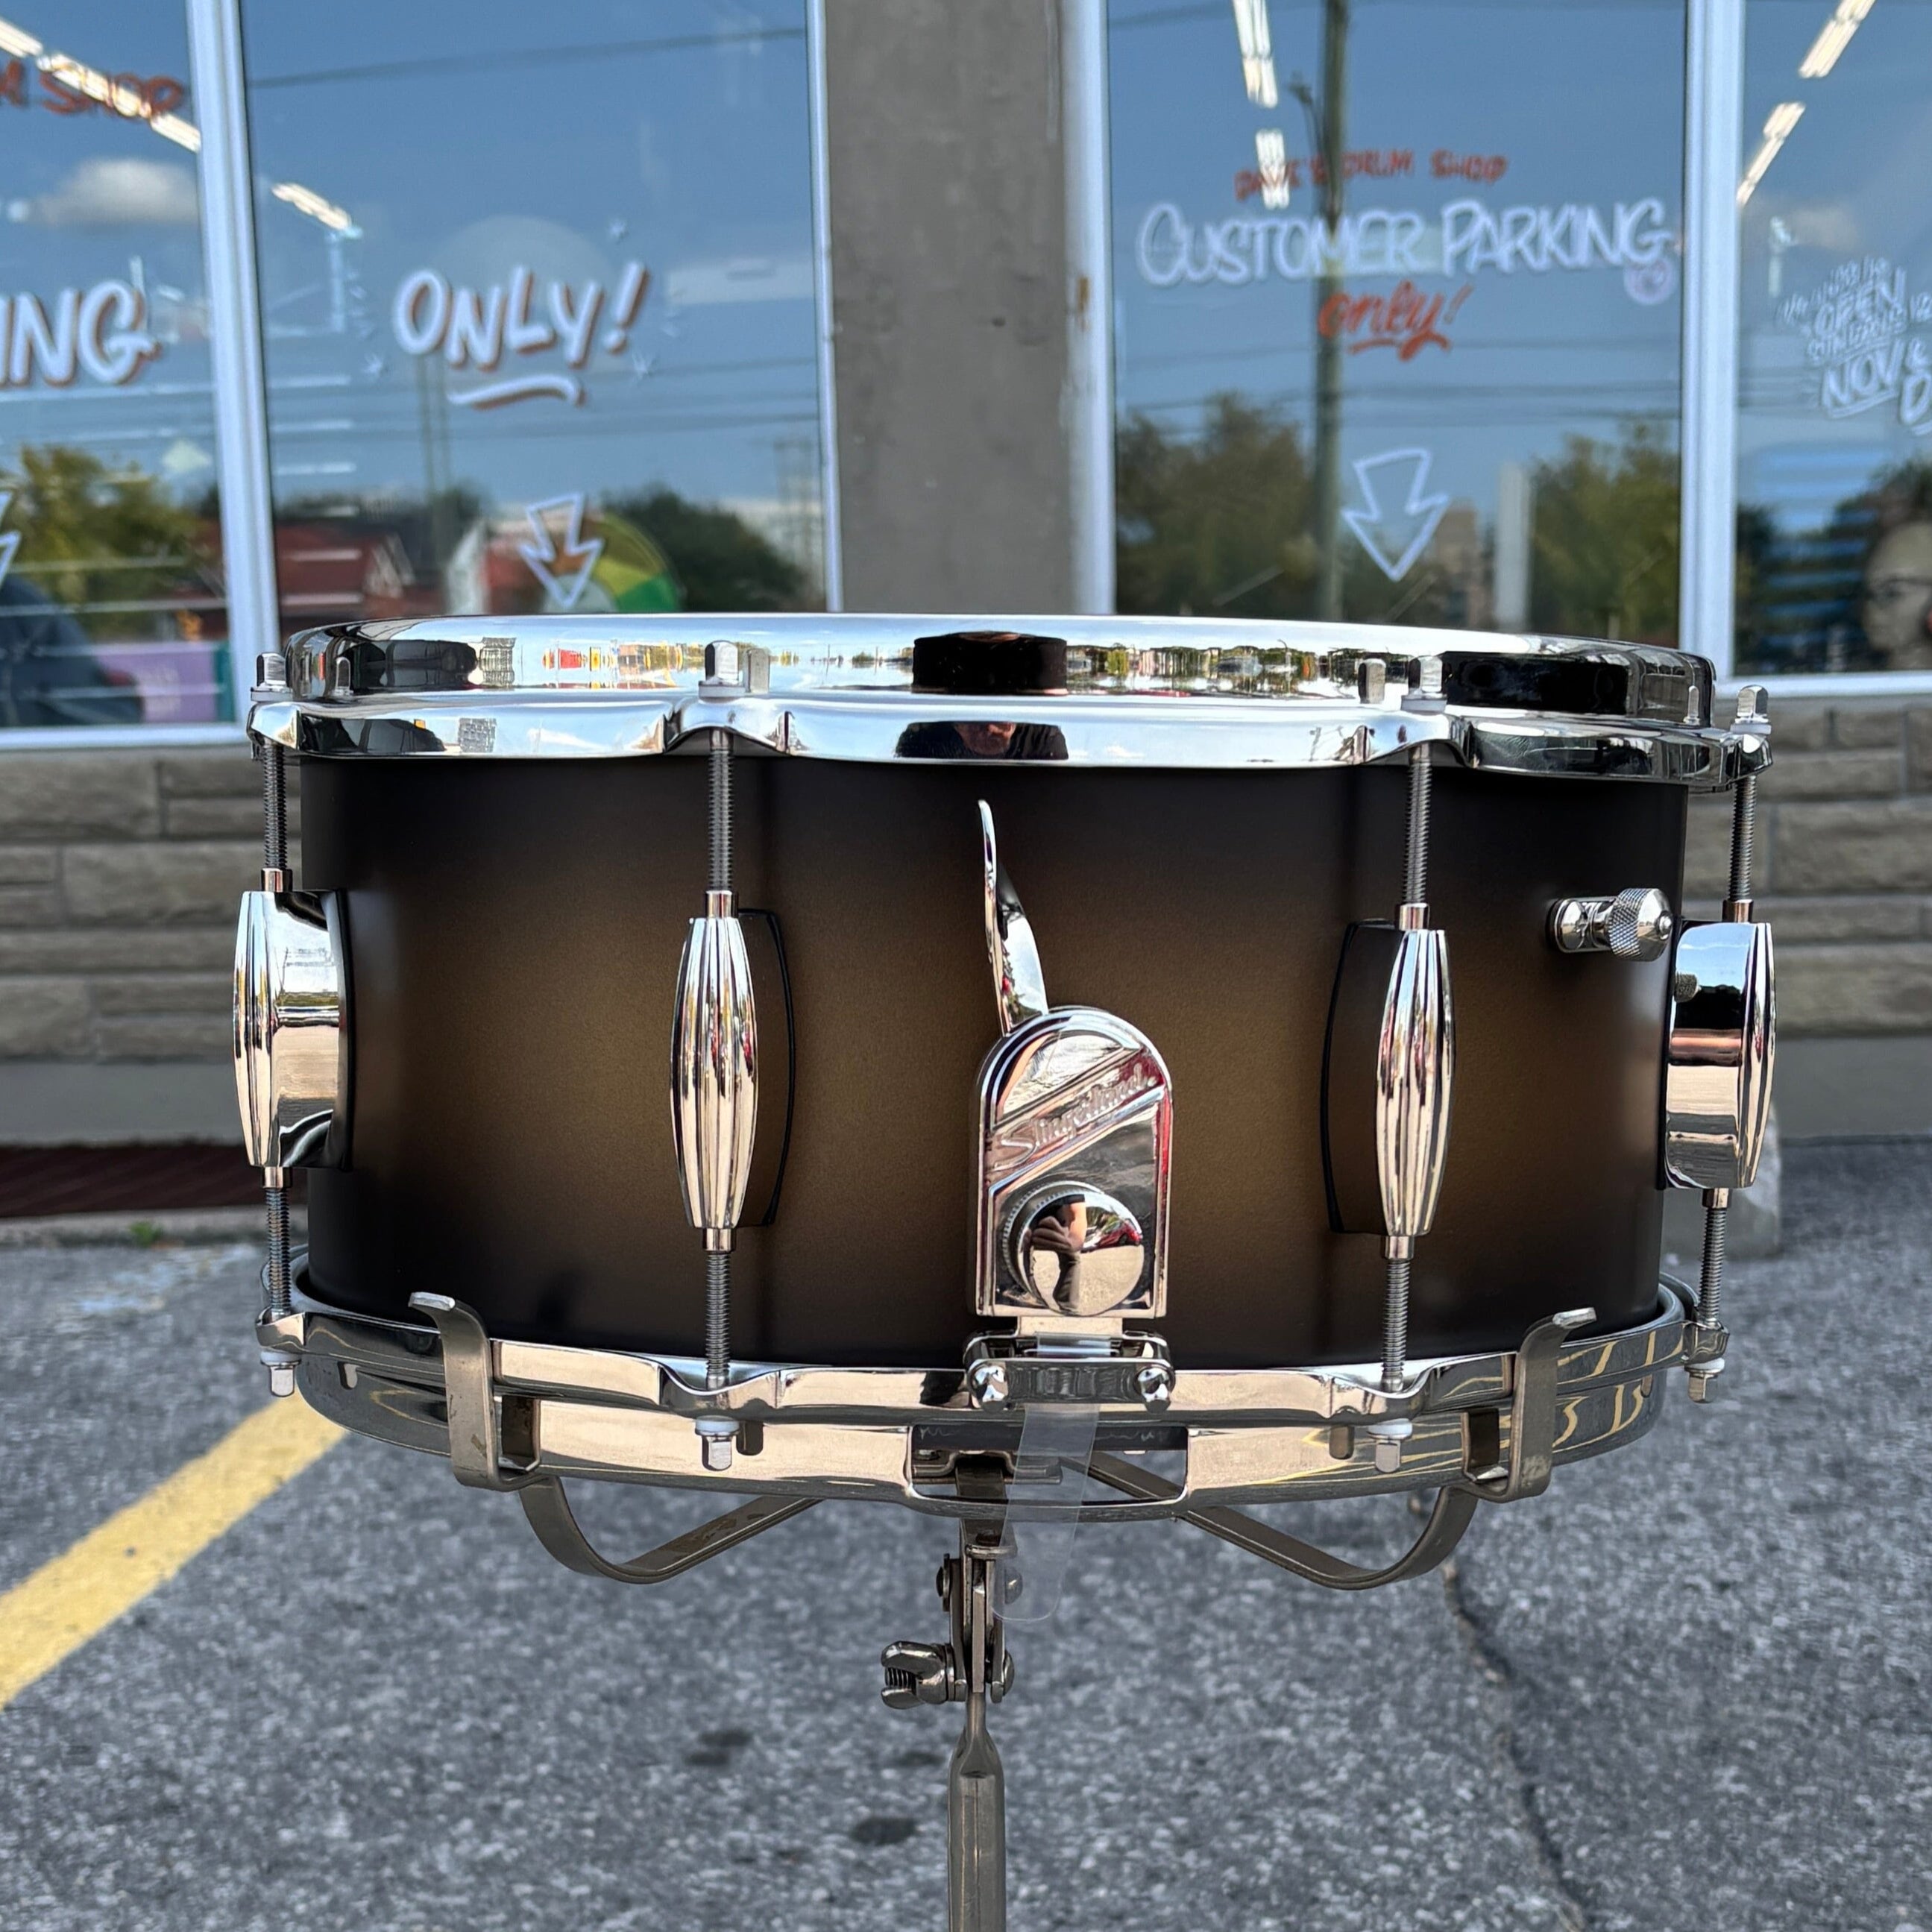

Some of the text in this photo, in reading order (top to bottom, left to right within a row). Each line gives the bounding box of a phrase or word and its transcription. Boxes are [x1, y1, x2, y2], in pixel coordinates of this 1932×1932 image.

[1137, 197, 1675, 286] CUSTOMER PARKING
[392, 261, 651, 371] ONLY!
[1821, 338, 1907, 409] NOV
